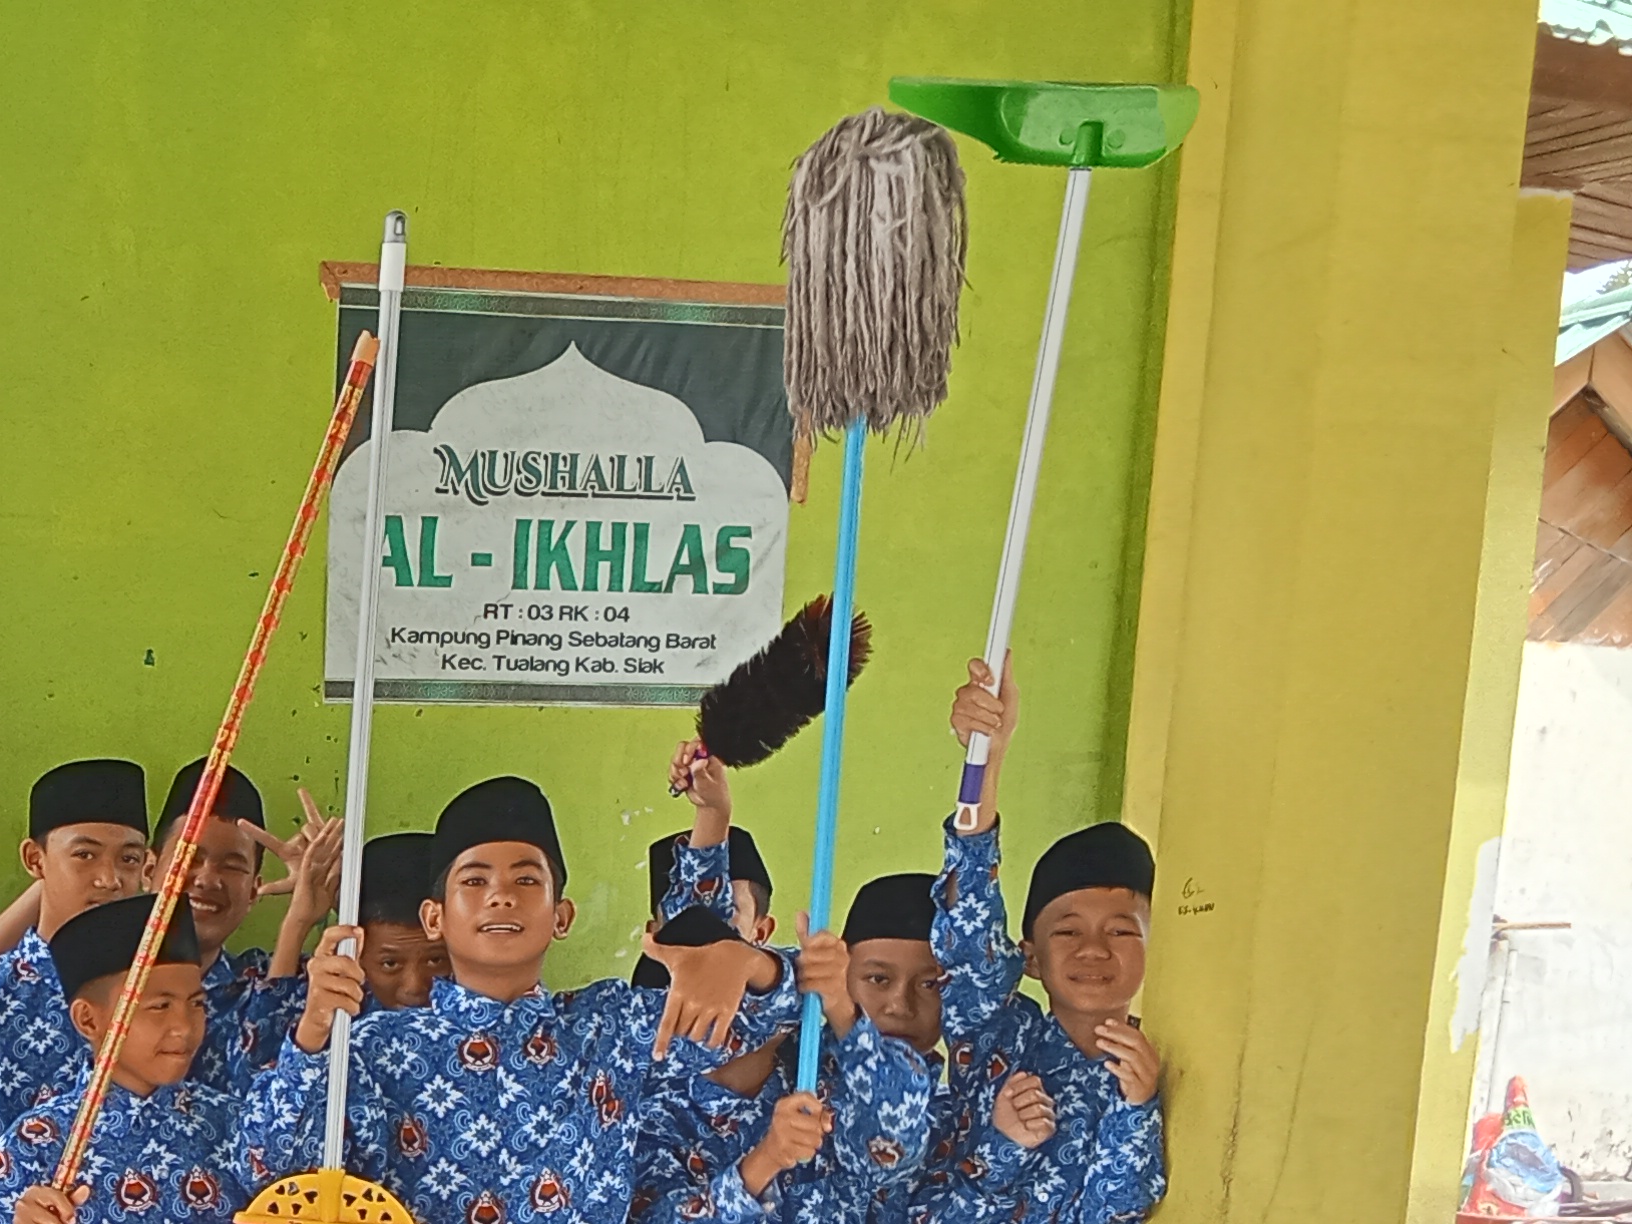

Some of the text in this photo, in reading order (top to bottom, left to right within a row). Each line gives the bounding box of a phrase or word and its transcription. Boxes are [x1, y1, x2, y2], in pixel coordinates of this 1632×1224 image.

[433, 444, 697, 506] MUSHALLA
[381, 514, 453, 588] AL
[510, 518, 753, 595] IKHLAS
[482, 603, 514, 620] RT
[527, 604, 554, 621] 03
[559, 605, 590, 622] RK
[603, 606, 631, 623] 04
[390, 627, 717, 653] Kampung Pinang Sebatang Barat
[440, 653, 666, 677] Kec. Tualang Kab. Siak
